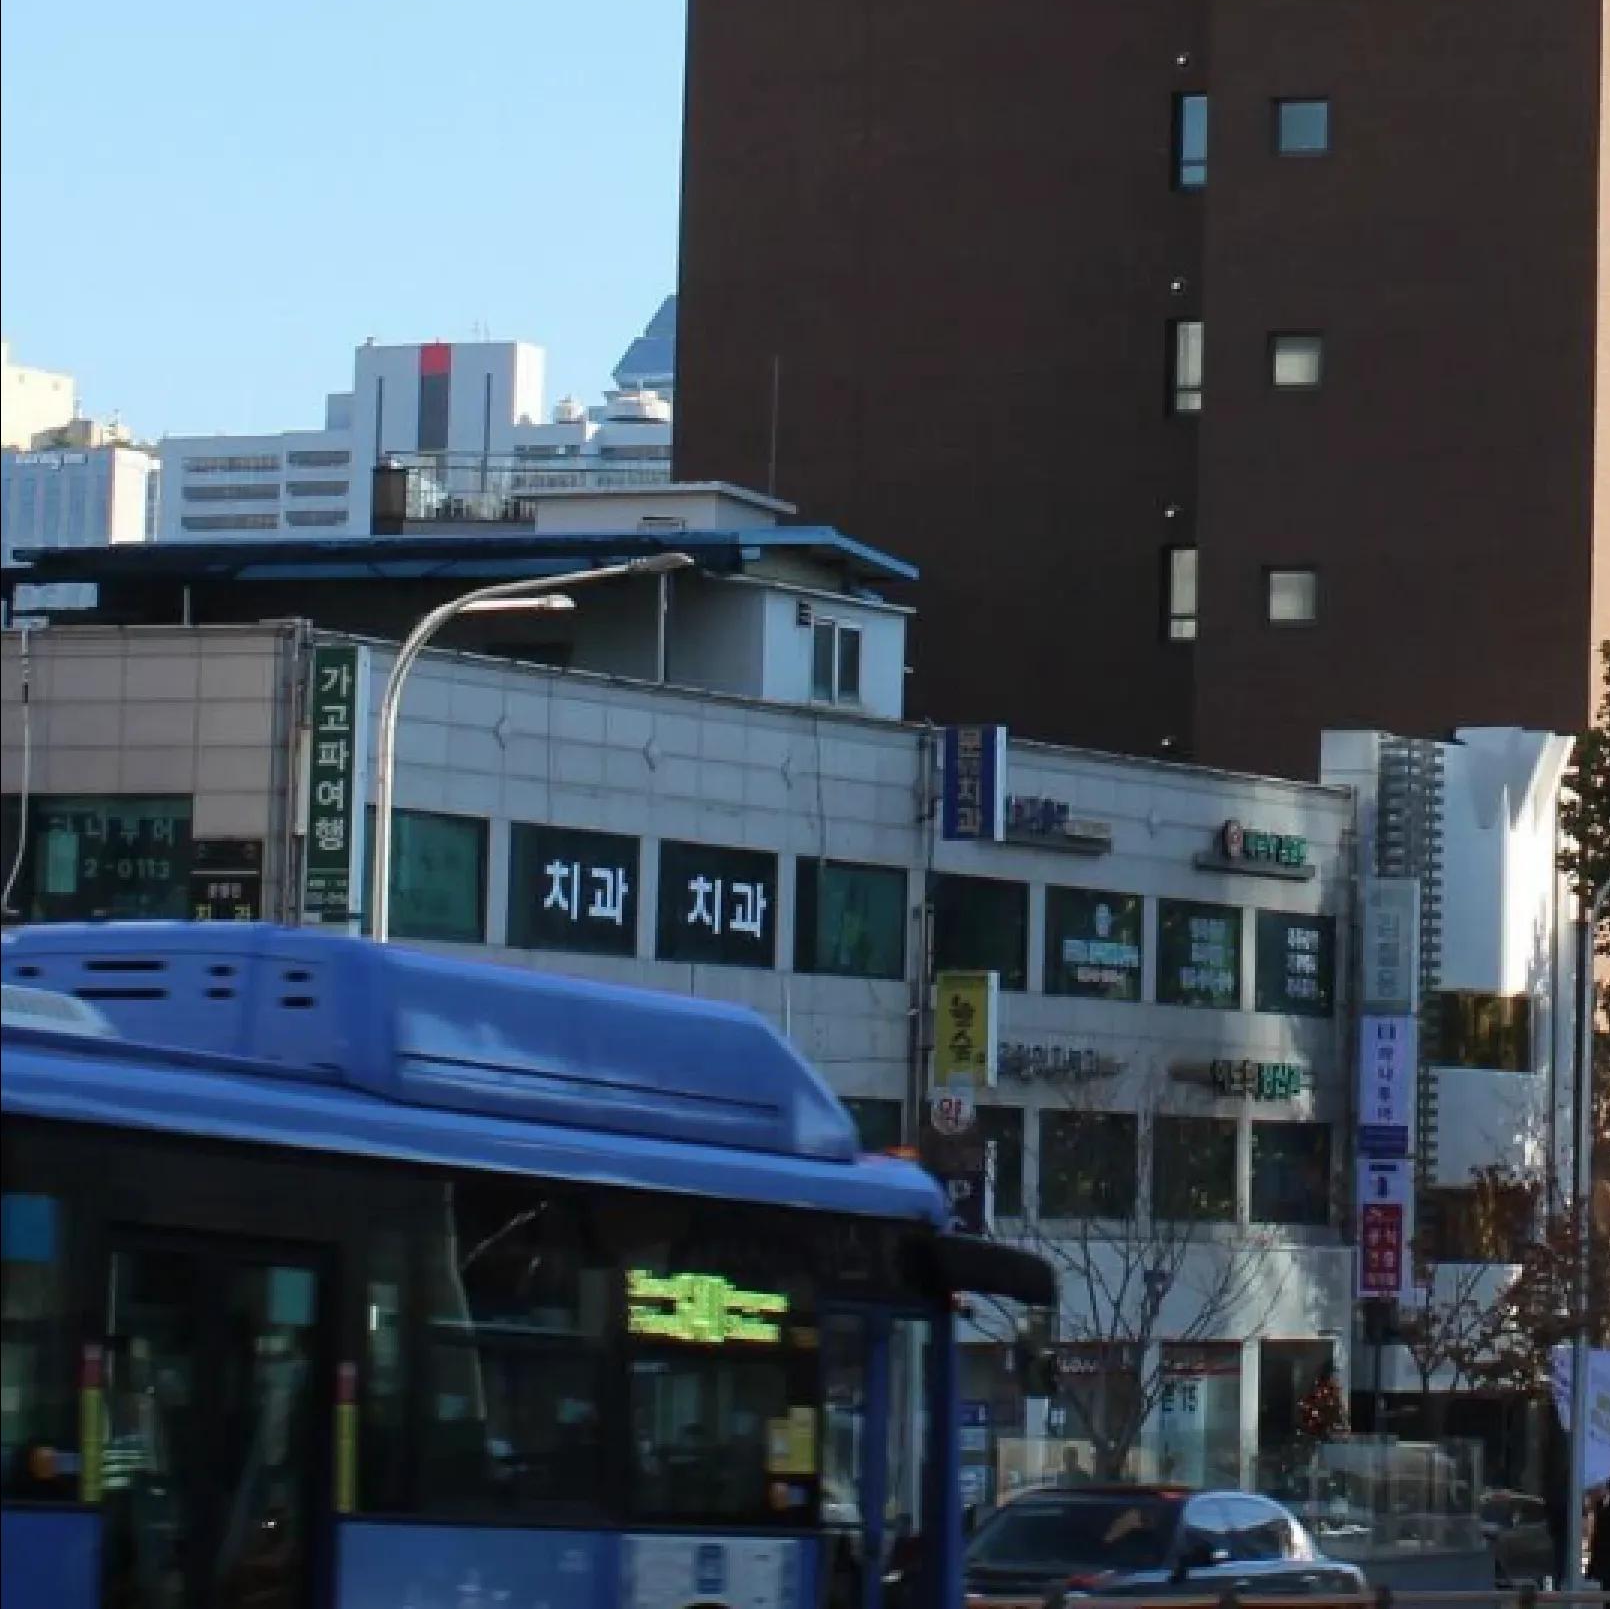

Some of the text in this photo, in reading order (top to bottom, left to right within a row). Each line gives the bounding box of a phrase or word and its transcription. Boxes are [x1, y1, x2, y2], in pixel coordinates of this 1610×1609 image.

[315, 663, 352, 851] 가고파여행
[543, 858, 767, 939] 치과 치과
